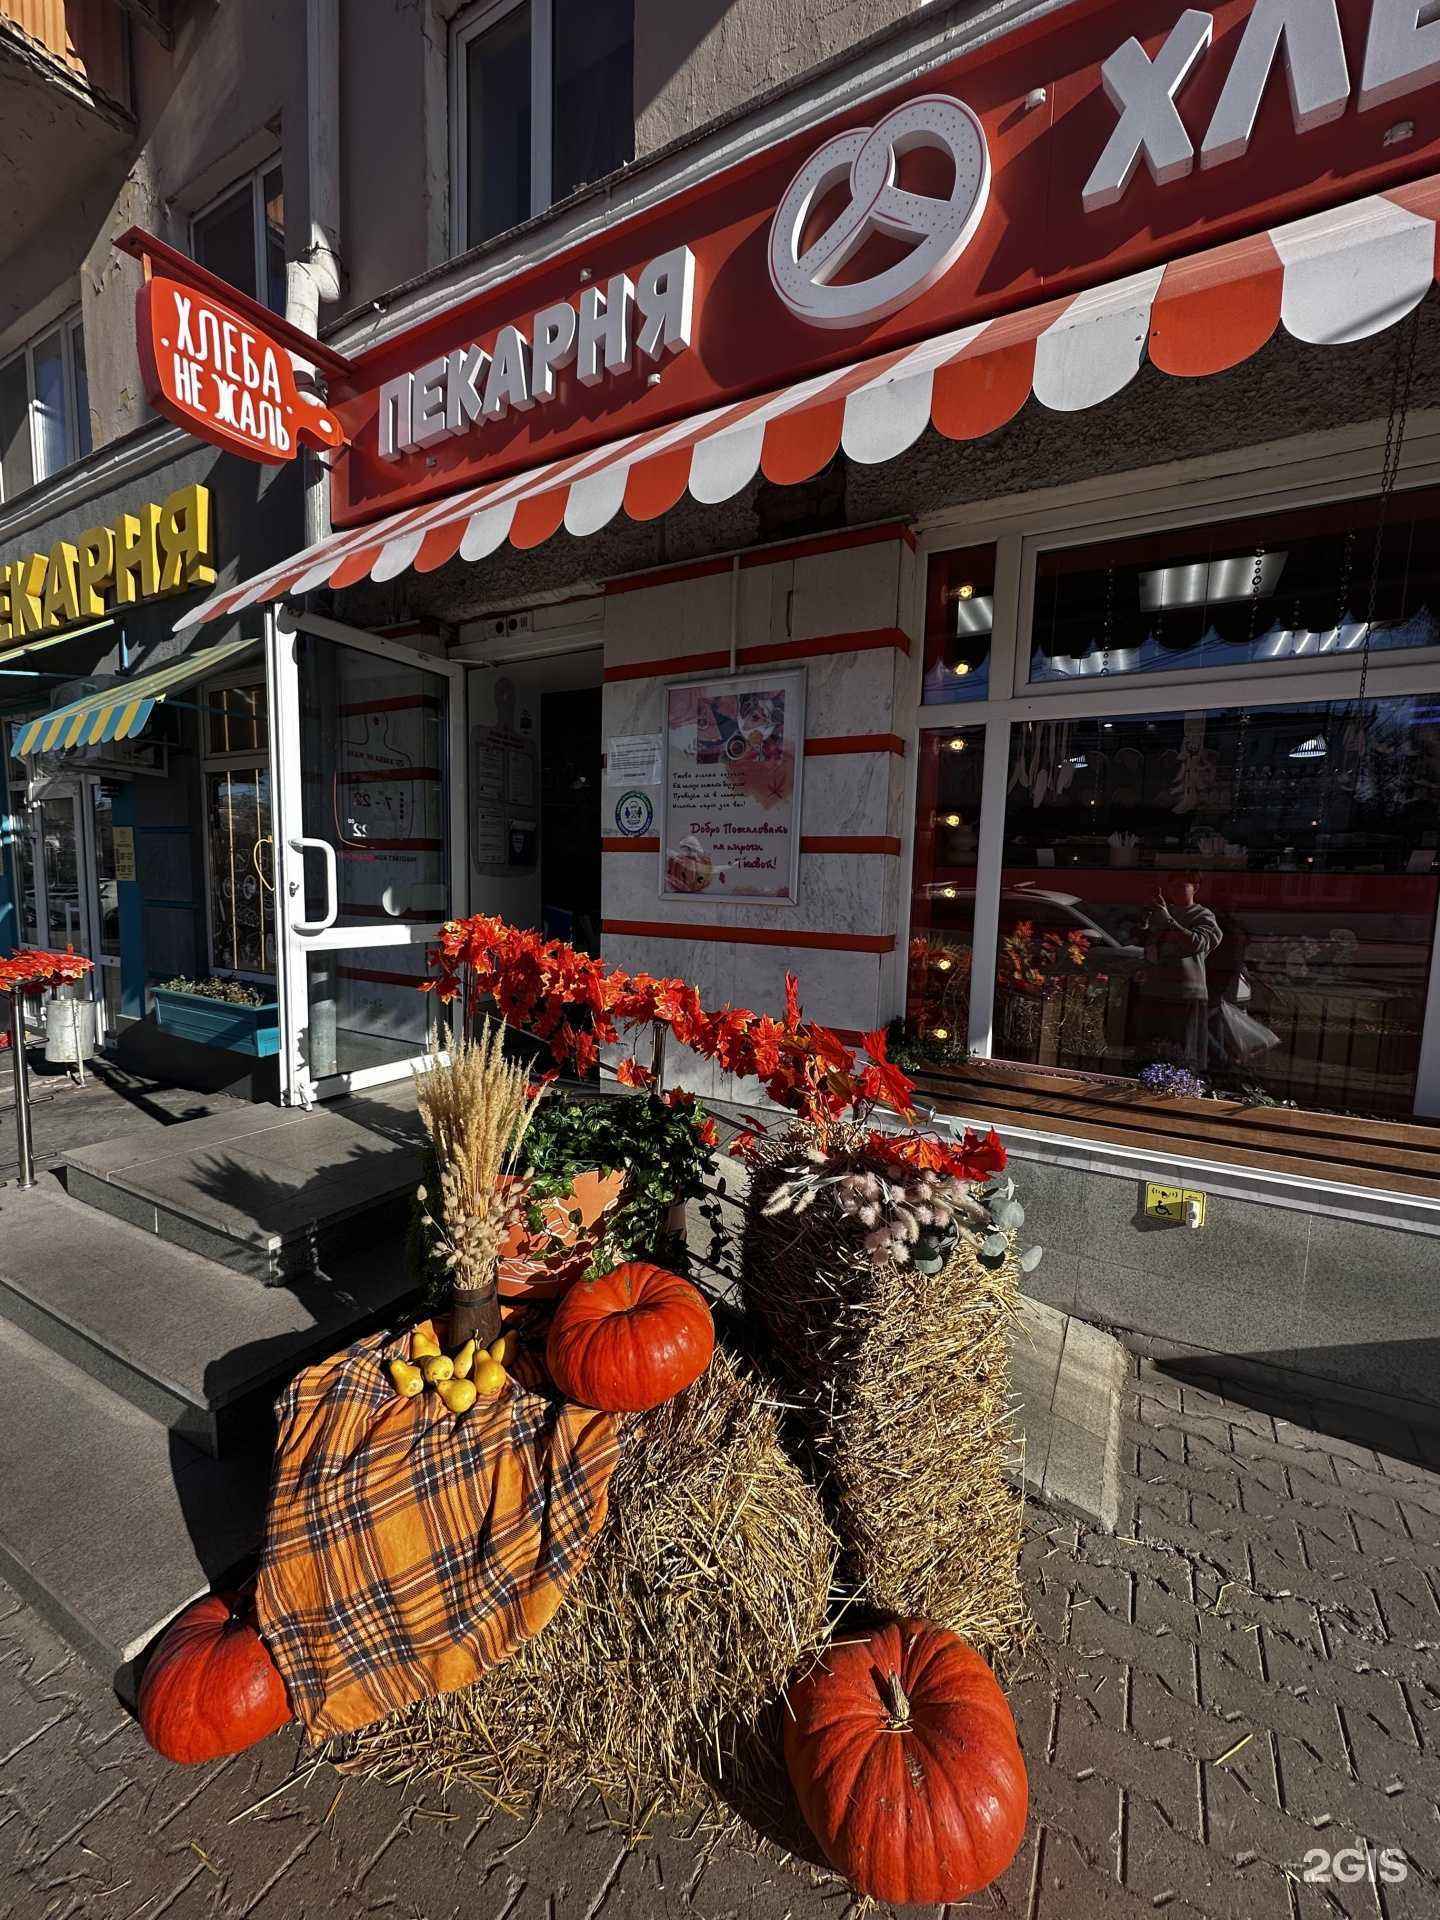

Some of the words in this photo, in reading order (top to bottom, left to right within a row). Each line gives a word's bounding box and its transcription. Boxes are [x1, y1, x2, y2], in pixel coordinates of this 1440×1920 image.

[173, 291, 282, 404] ХЛЕБА
[378, 245, 696, 463] ПЕКАРНЯ
[173, 352, 208, 413] НЕ
[211, 373, 291, 452] ЖАЛЬ
[690, 821, 720, 837] Добро
[722, 822, 788, 834] Пожаловать
